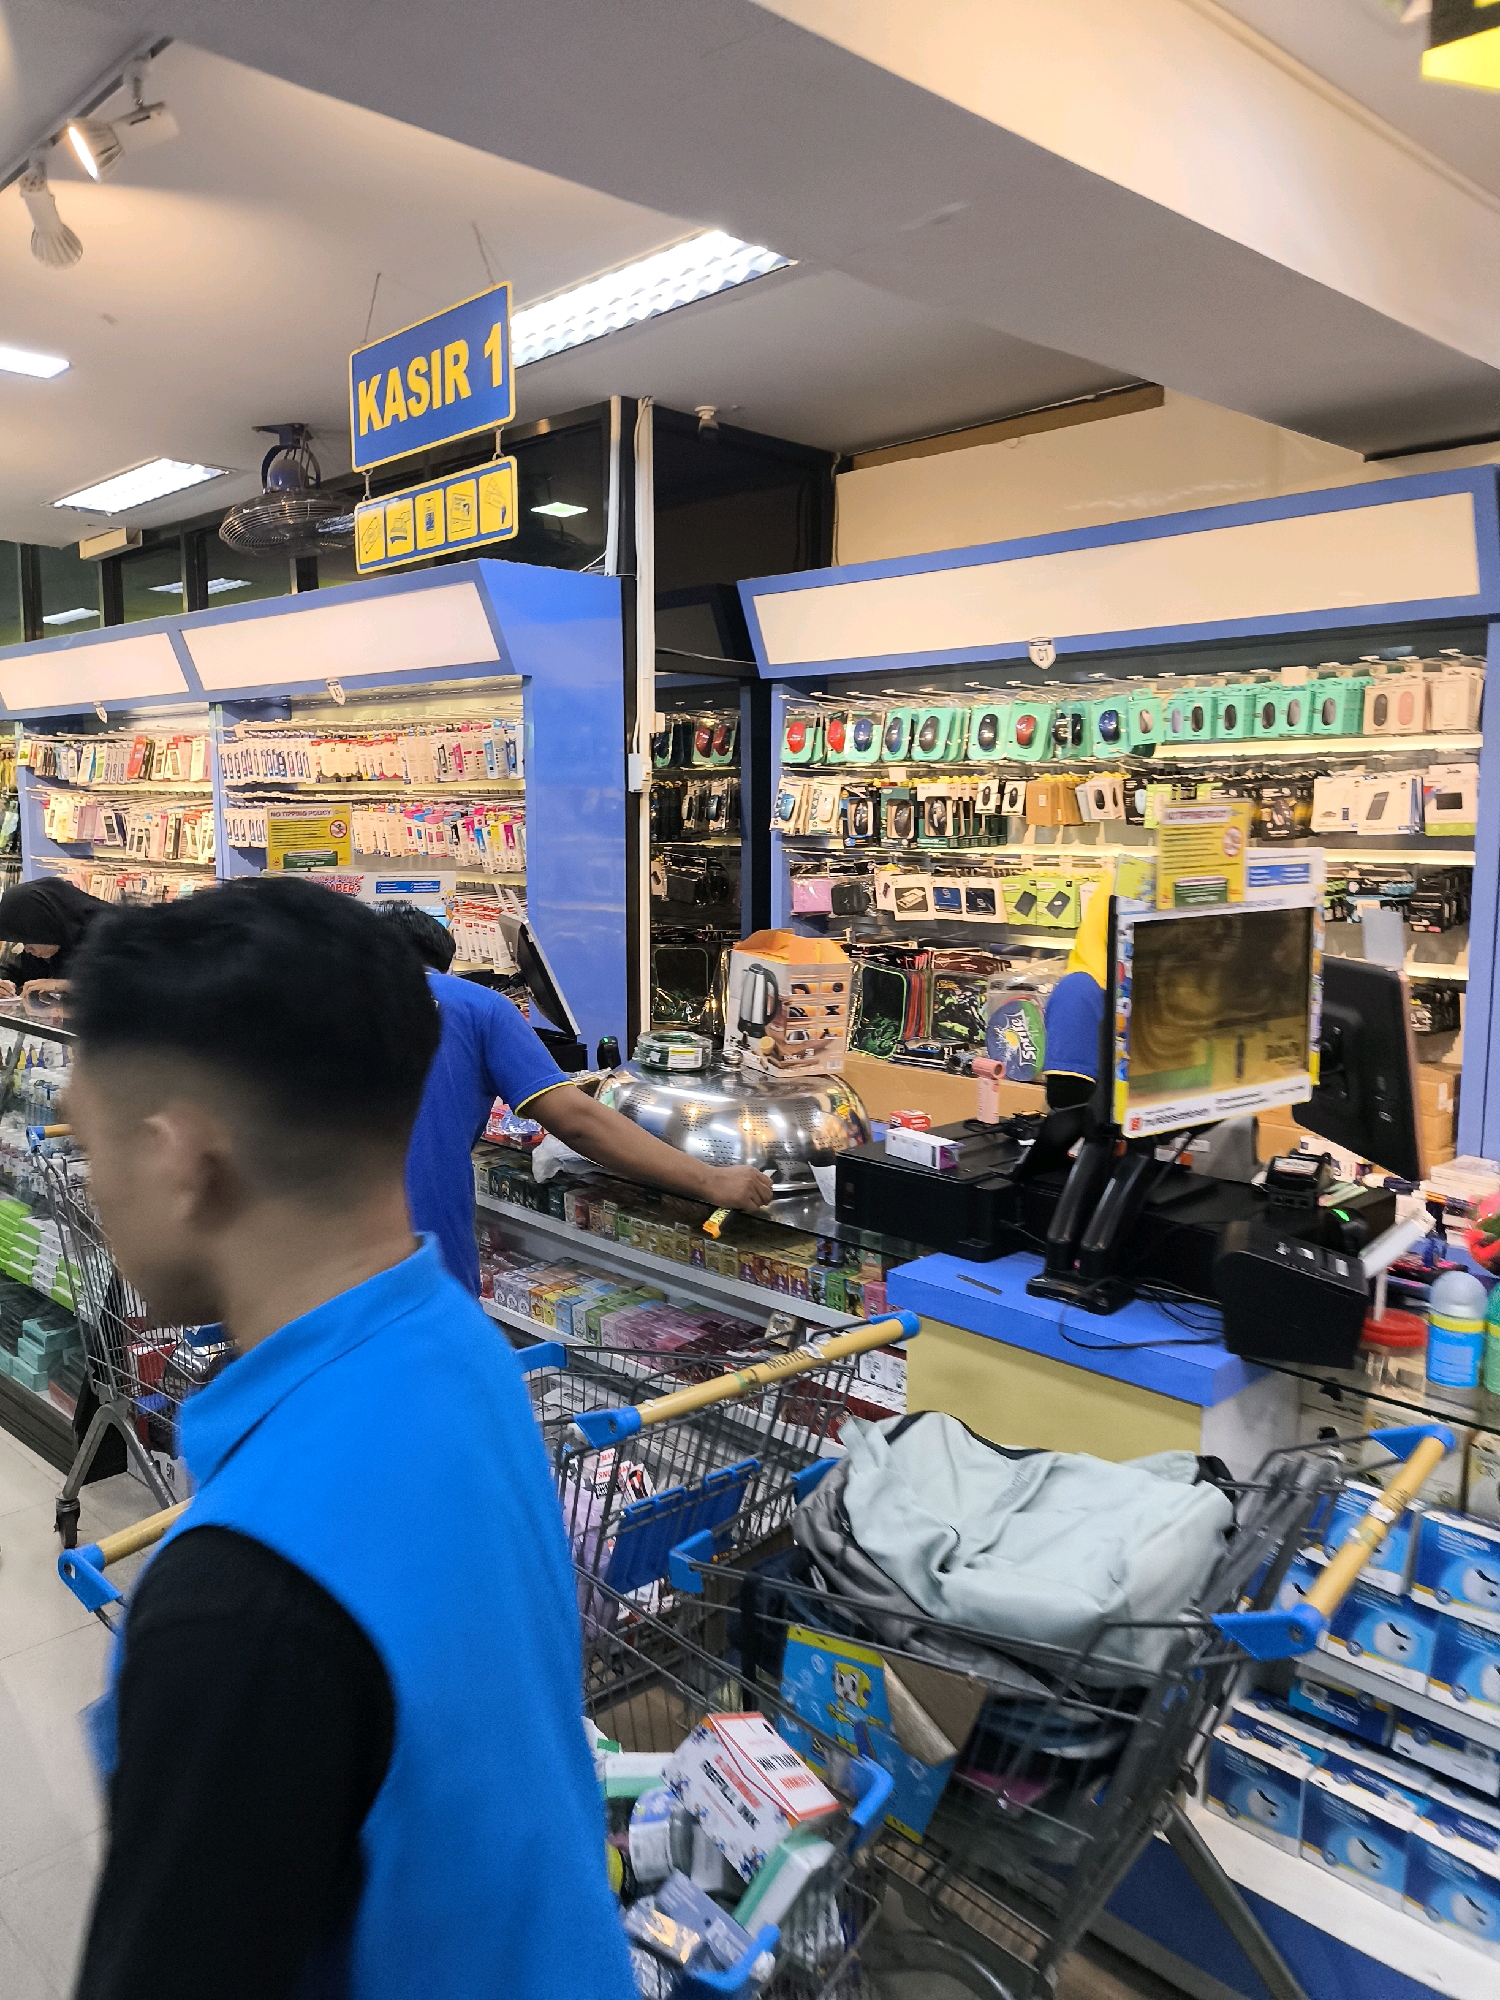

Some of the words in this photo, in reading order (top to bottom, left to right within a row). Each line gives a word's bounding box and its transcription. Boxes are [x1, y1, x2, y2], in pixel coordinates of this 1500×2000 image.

[358, 339, 472, 437] KASIR
[484, 321, 503, 388] 1
[1011, 1017, 1037, 1060] Sprite
